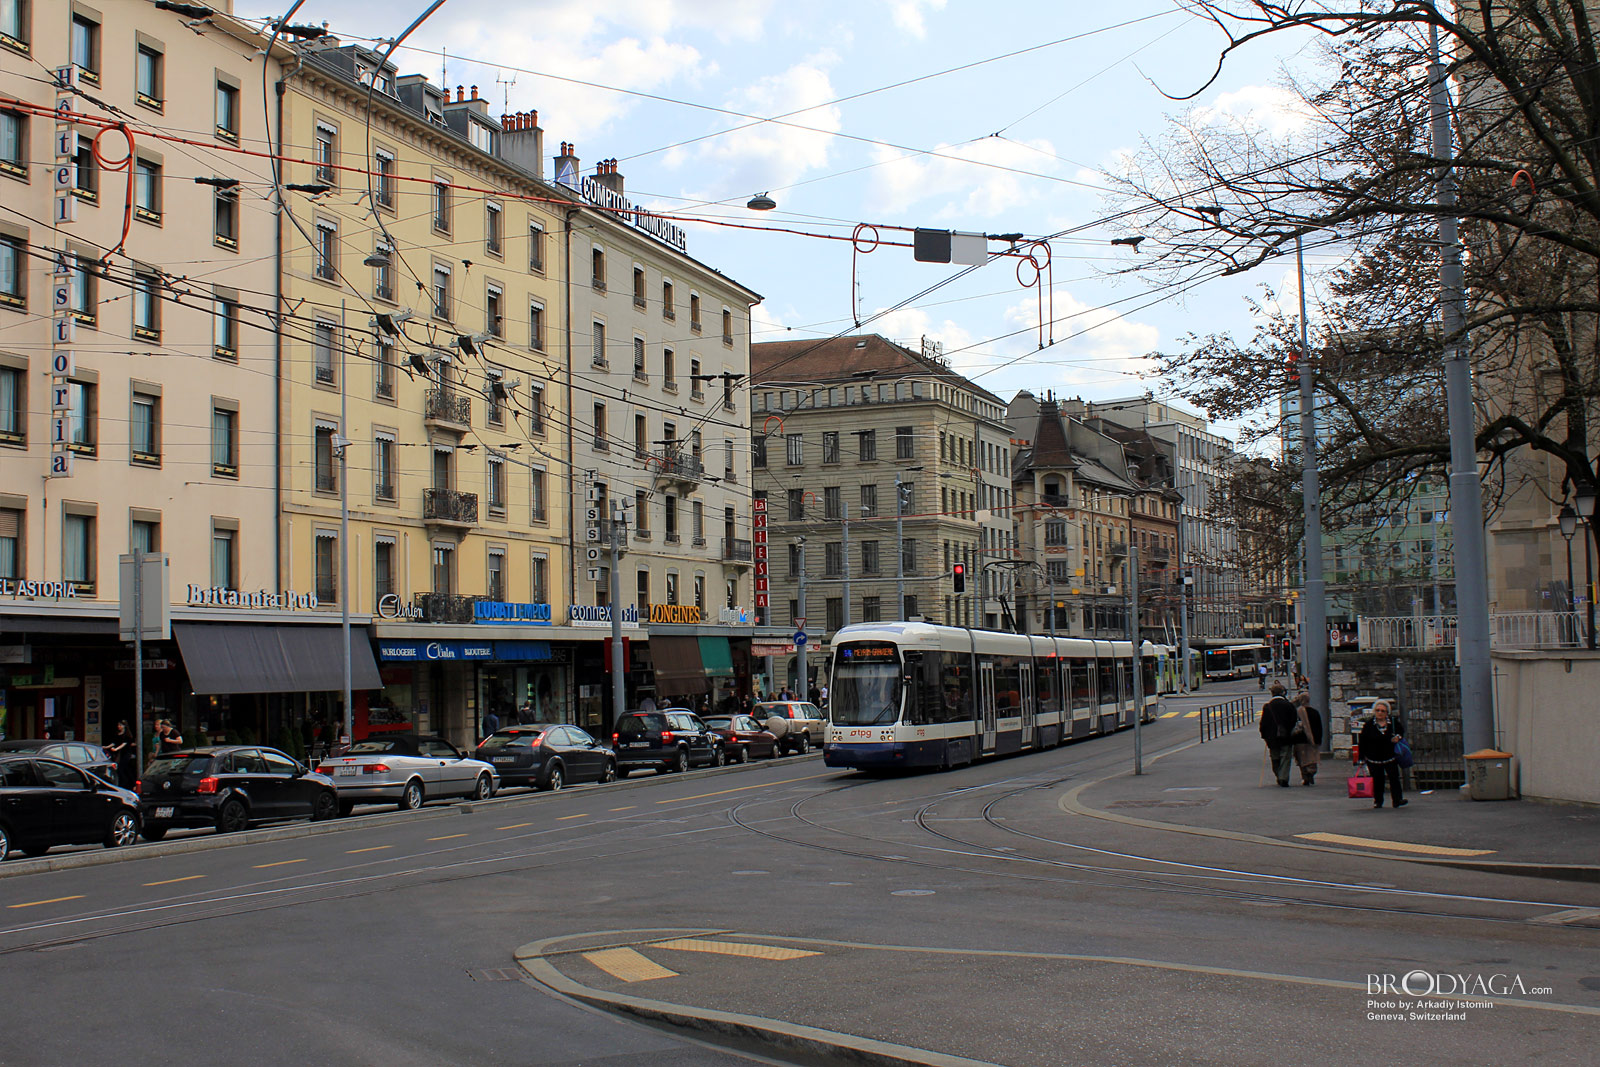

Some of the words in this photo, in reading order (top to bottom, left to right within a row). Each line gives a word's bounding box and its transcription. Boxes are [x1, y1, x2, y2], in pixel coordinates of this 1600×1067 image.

[56, 67, 72, 220] Hôtel
[582, 176, 632, 222] COMPTOIR
[635, 205, 687, 251] IMMOBILIER
[53, 252, 69, 473] Astoria
[755, 501, 764, 511] La
[587, 470, 598, 579] TISSOT
[17, 580, 77, 598] ASTORIA
[187, 583, 279, 607] Britannia
[285, 589, 319, 611] Pub
[377, 593, 424, 619] Clinton
[648, 603, 700, 624] LONGINES
[382, 648, 417, 657] HORLOGERIE
[426, 642, 455, 659] Clinton
[857, 729, 872, 738] tpg
